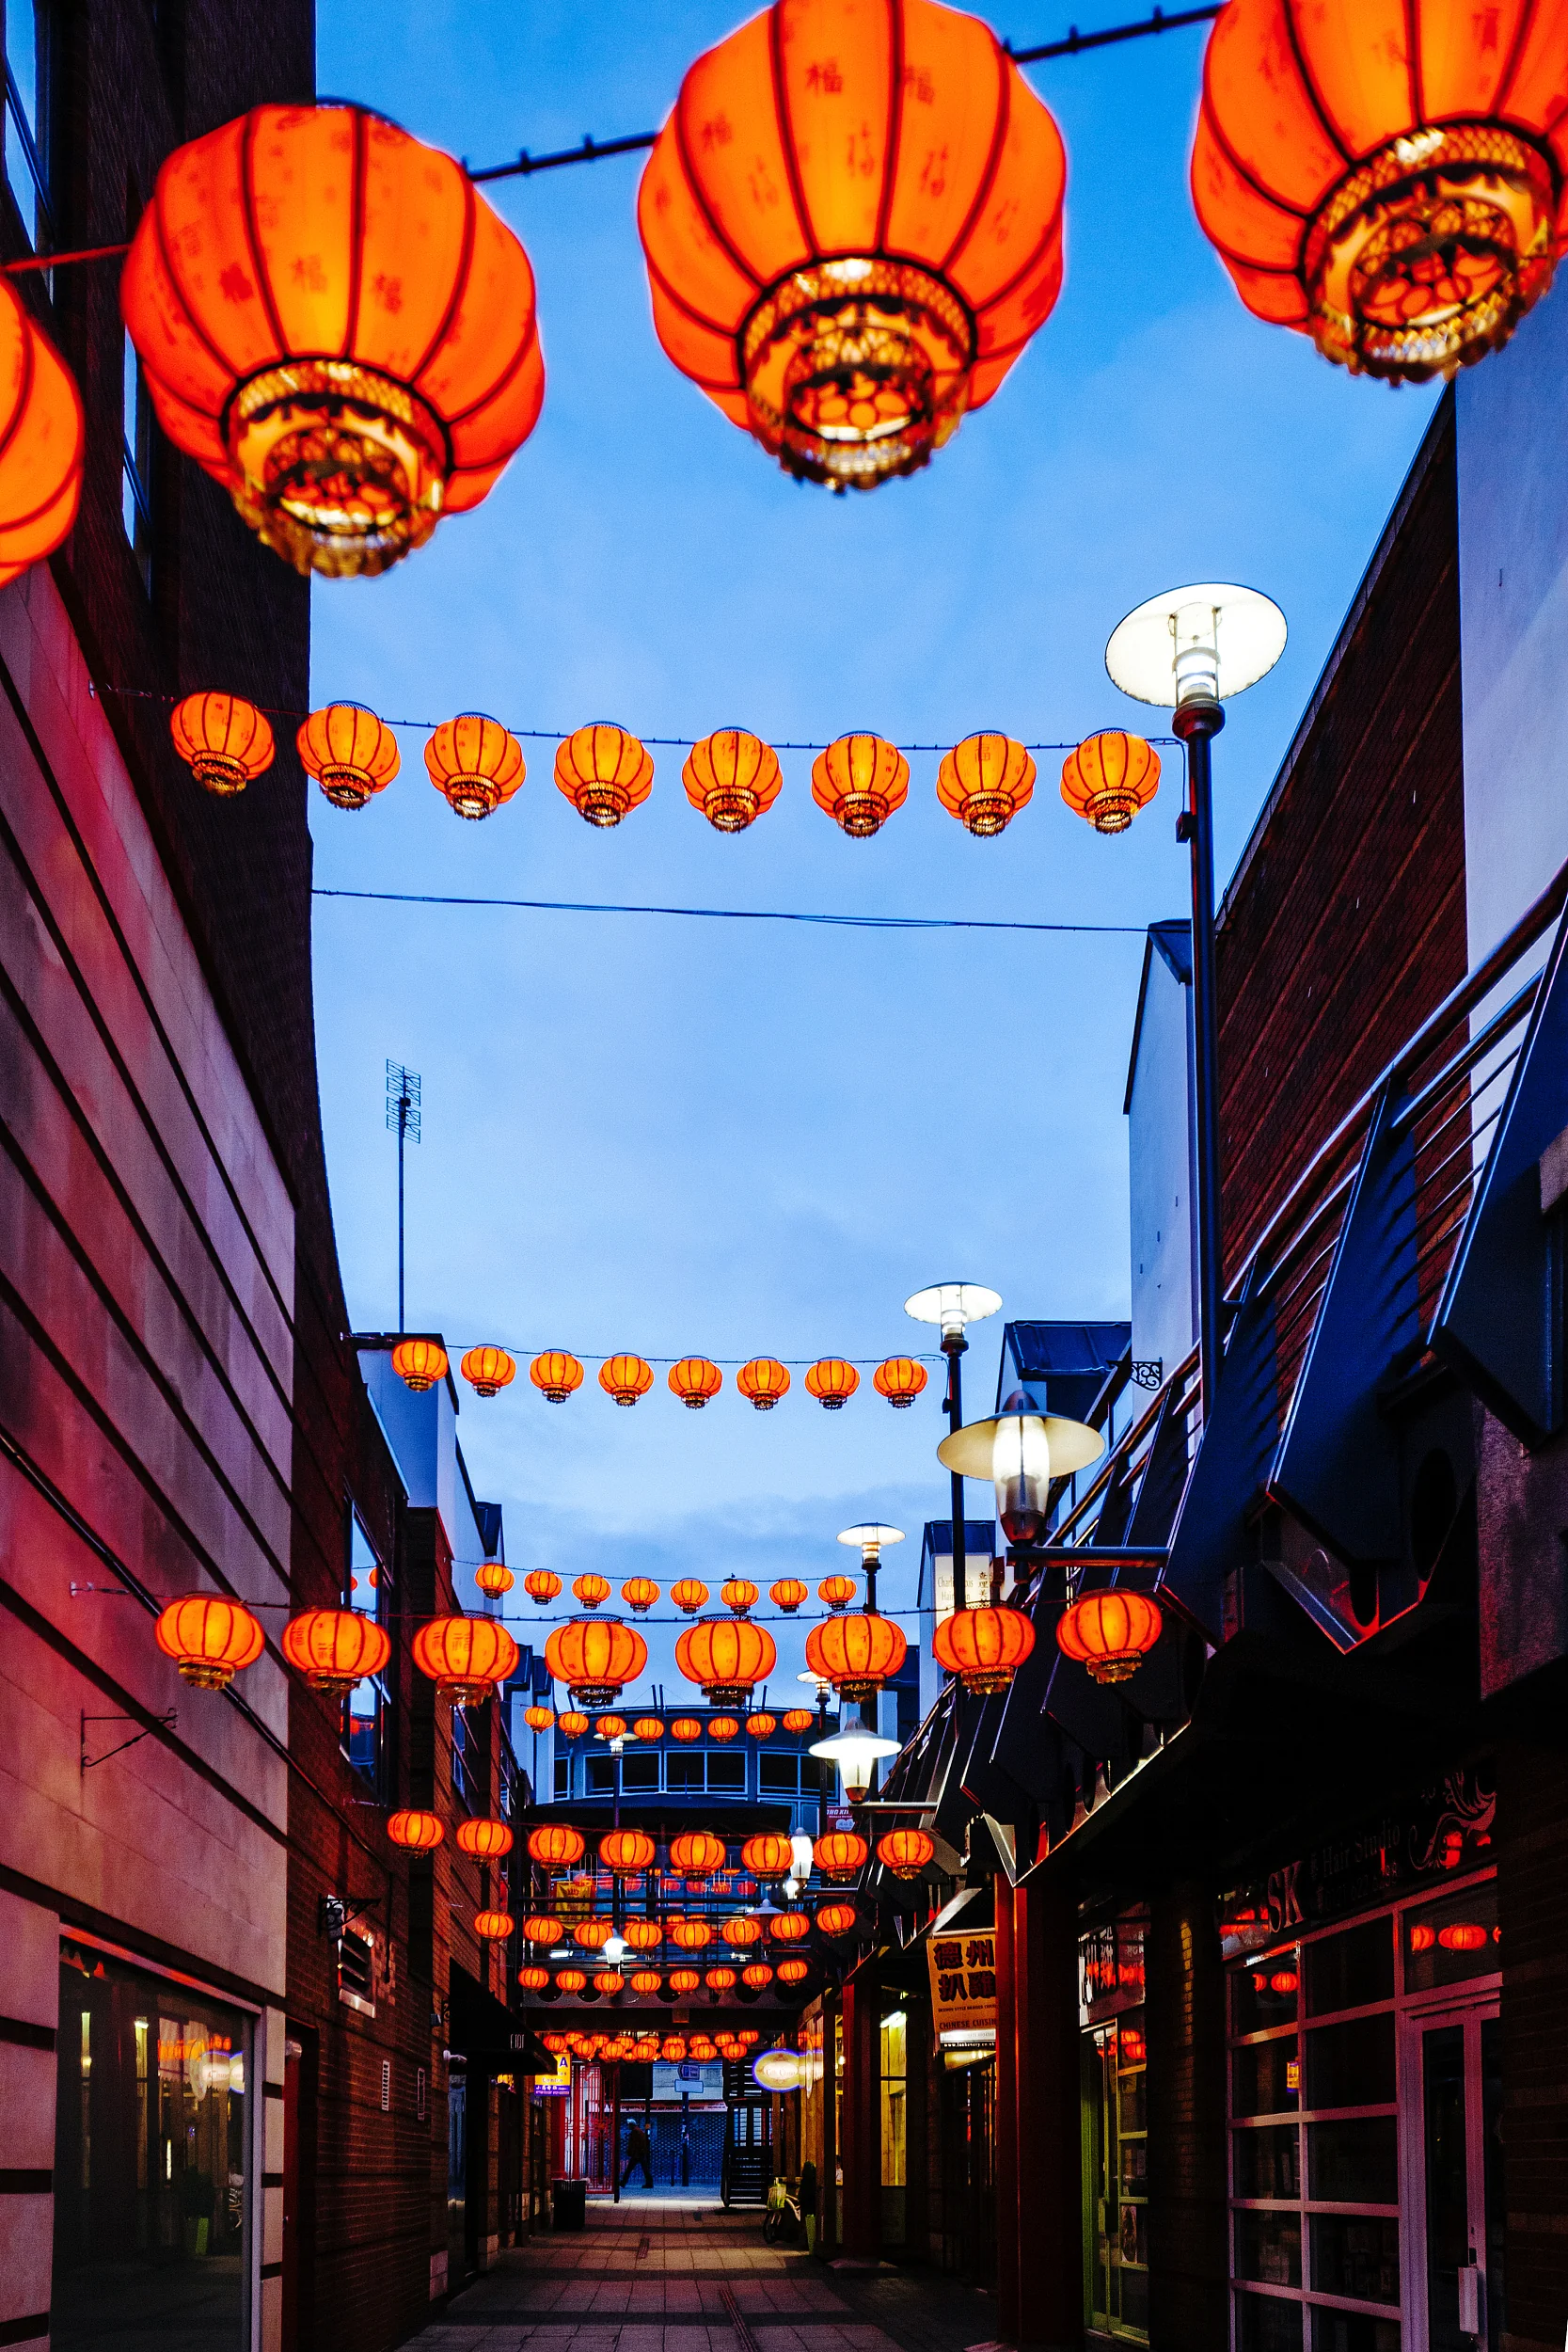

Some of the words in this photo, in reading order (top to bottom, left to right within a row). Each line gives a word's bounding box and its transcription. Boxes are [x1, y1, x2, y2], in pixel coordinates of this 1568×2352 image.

[1321, 1840, 1351, 1879] Hair
[1353, 1817, 1402, 1864] Studio
[1267, 1859, 1306, 1934] SK
[933, 1939, 995, 1970] 德州
[939, 2019, 970, 2030] CHINESE
[973, 2017, 997, 2027] CUISIN
